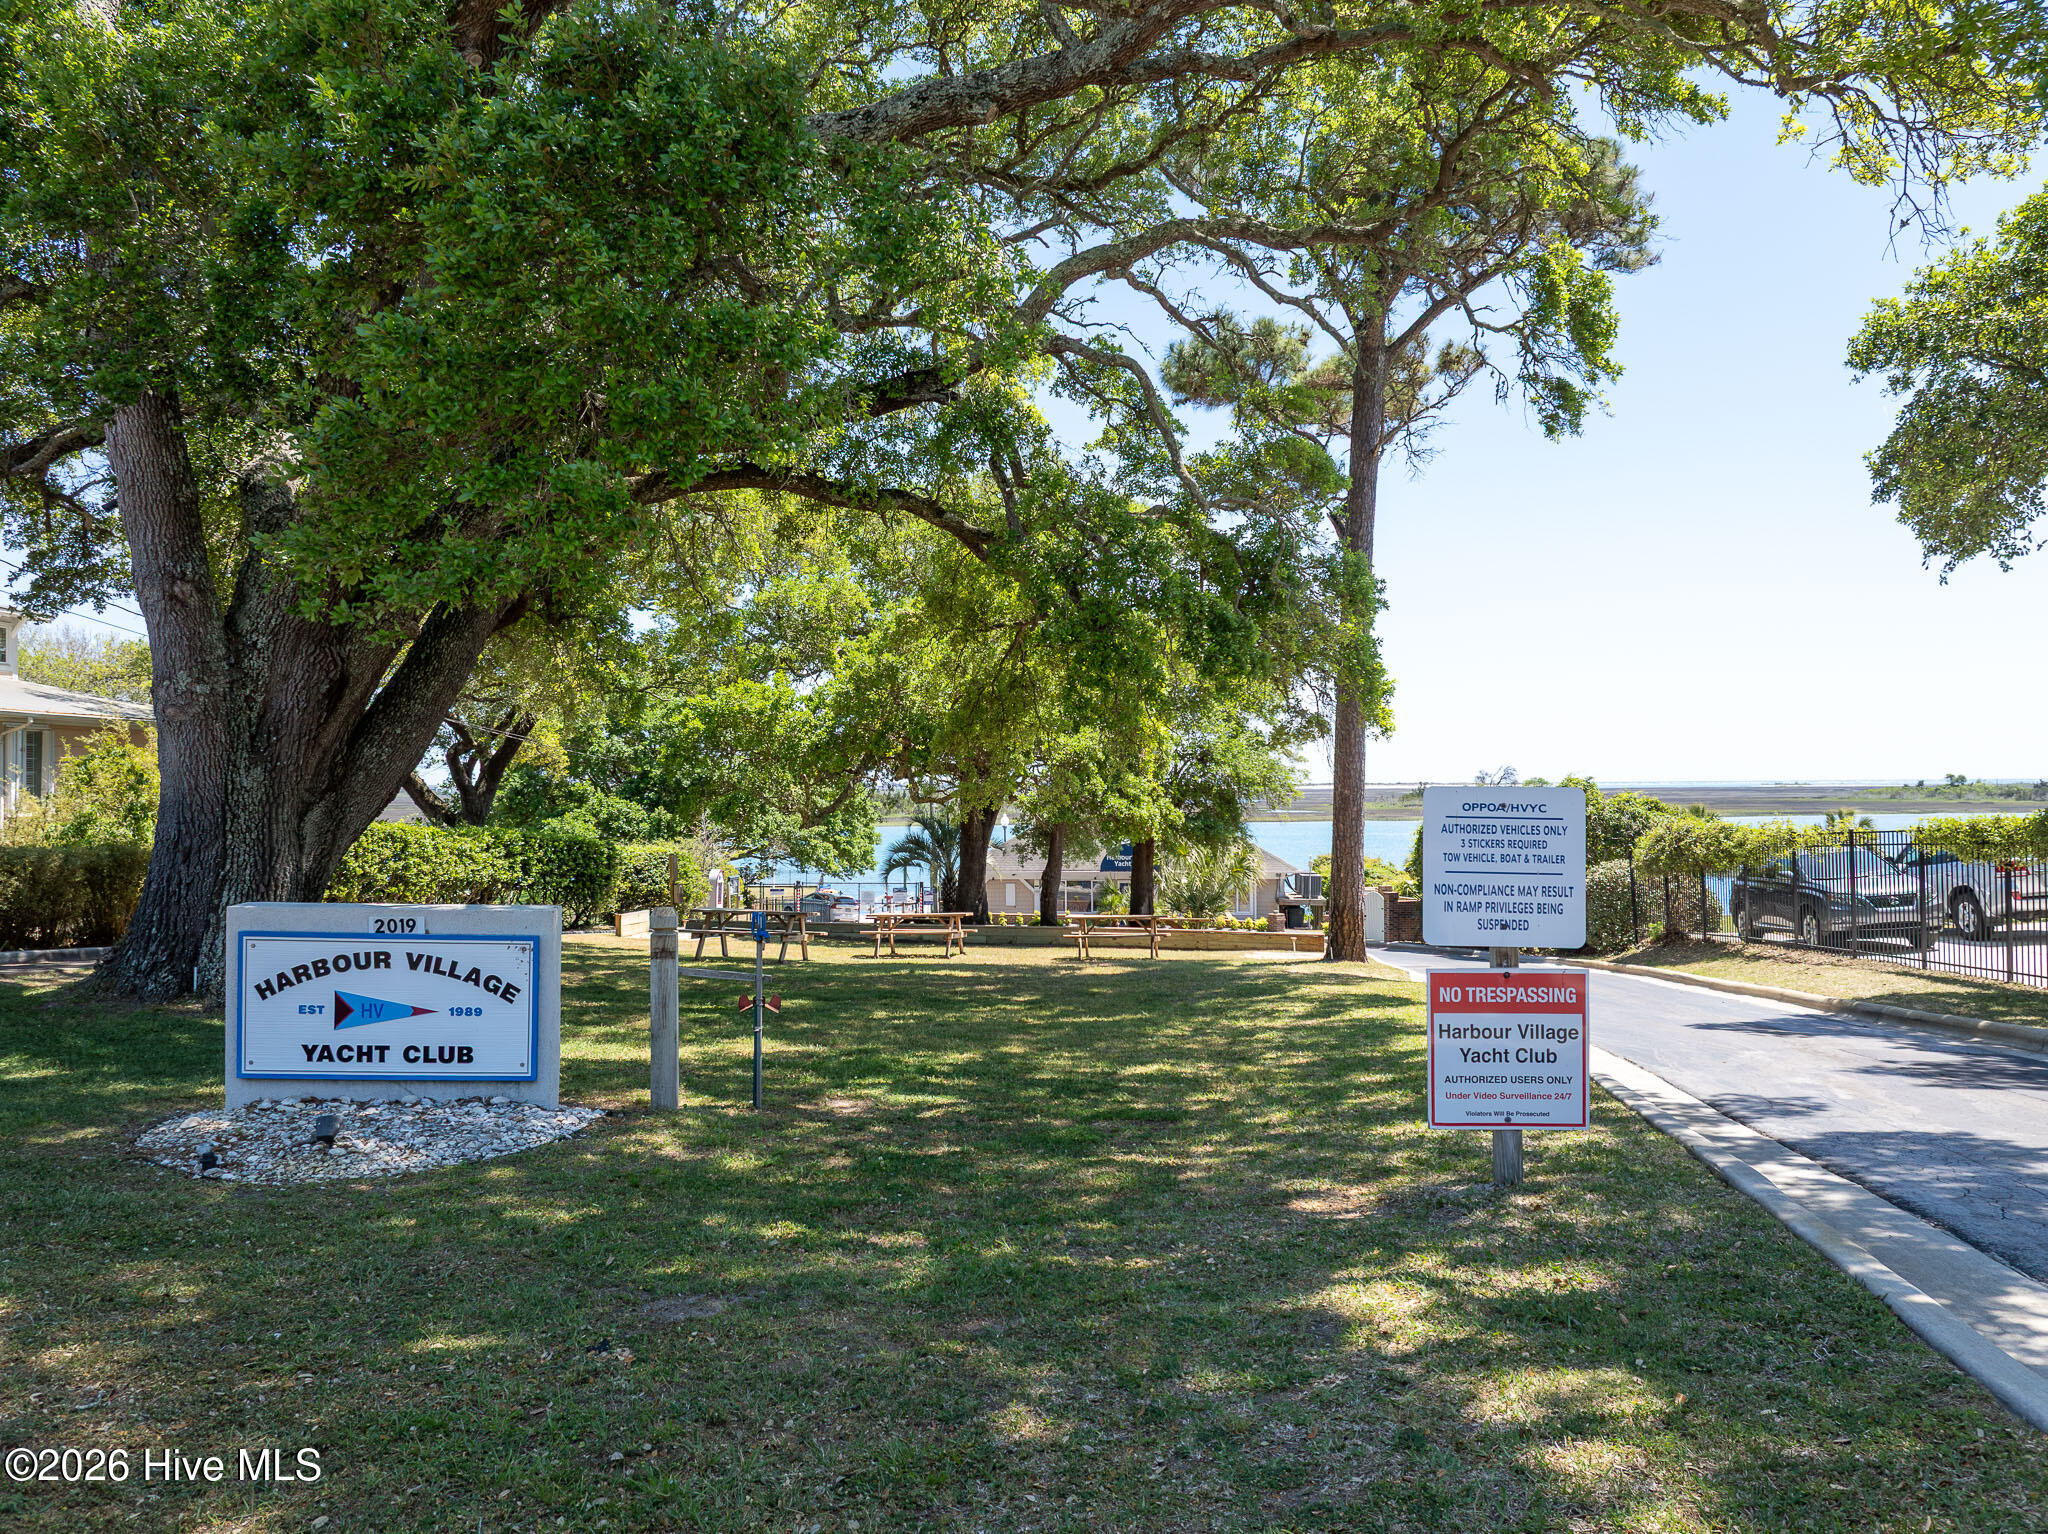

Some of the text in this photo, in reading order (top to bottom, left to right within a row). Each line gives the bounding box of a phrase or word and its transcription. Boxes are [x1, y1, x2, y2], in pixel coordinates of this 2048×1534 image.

[1462, 803, 1547, 813] OPPOA/HVYC
[1441, 823, 1568, 836] AUTHORIZED VEHICLES ONLY
[1461, 839, 1547, 850] 3 STICKERS REQUIRED
[1443, 852, 1565, 864] TOW VEHICLE, BOAT & TRAILER
[1434, 884, 1574, 898] NON-COMPLIANCE MAY RESULT
[1444, 901, 1563, 914] IN RAMP PRIVILEGES BEING
[374, 918, 416, 934] 2019
[1477, 919, 1529, 930] SUSPENDED
[253, 951, 522, 1005] HARBOUR VILLAGE
[1439, 987, 1576, 1003] NO TRESPASSING
[298, 1003, 482, 1019] EST HV 1989
[1439, 1024, 1579, 1043] Harbour Village
[301, 1044, 474, 1064] YACHT CLUB
[1460, 1048, 1557, 1063] Yacht Club
[1444, 1076, 1573, 1084] AUTHORIZED USERS ONLY
[1446, 1092, 1471, 1100] Under
[1473, 1092, 1497, 1100] Video
[1500, 1092, 1552, 1100] Surveillance
